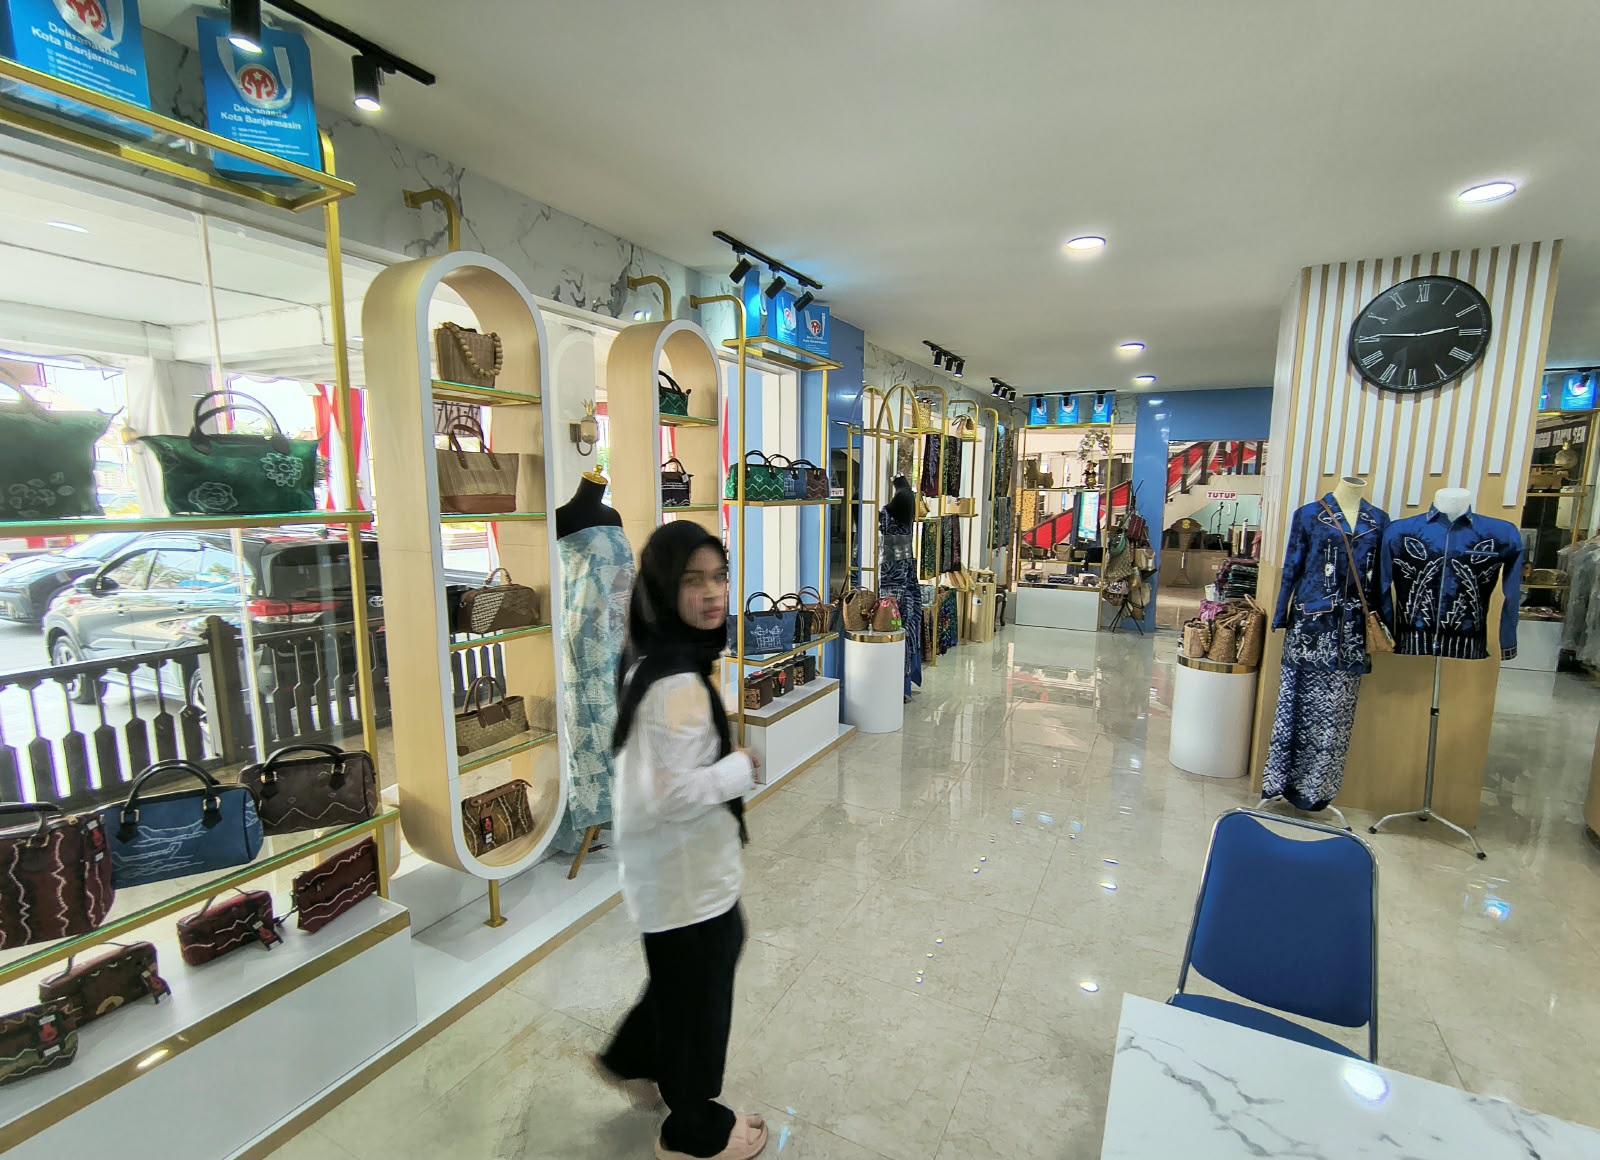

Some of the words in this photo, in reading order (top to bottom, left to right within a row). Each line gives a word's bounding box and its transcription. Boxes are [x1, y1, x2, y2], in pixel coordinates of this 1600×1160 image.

[31, 25, 62, 47] Kota
[64, 39, 137, 76] Banjarmasin
[220, 111, 243, 123] Kota
[244, 114, 302, 130] Banjarmasin
